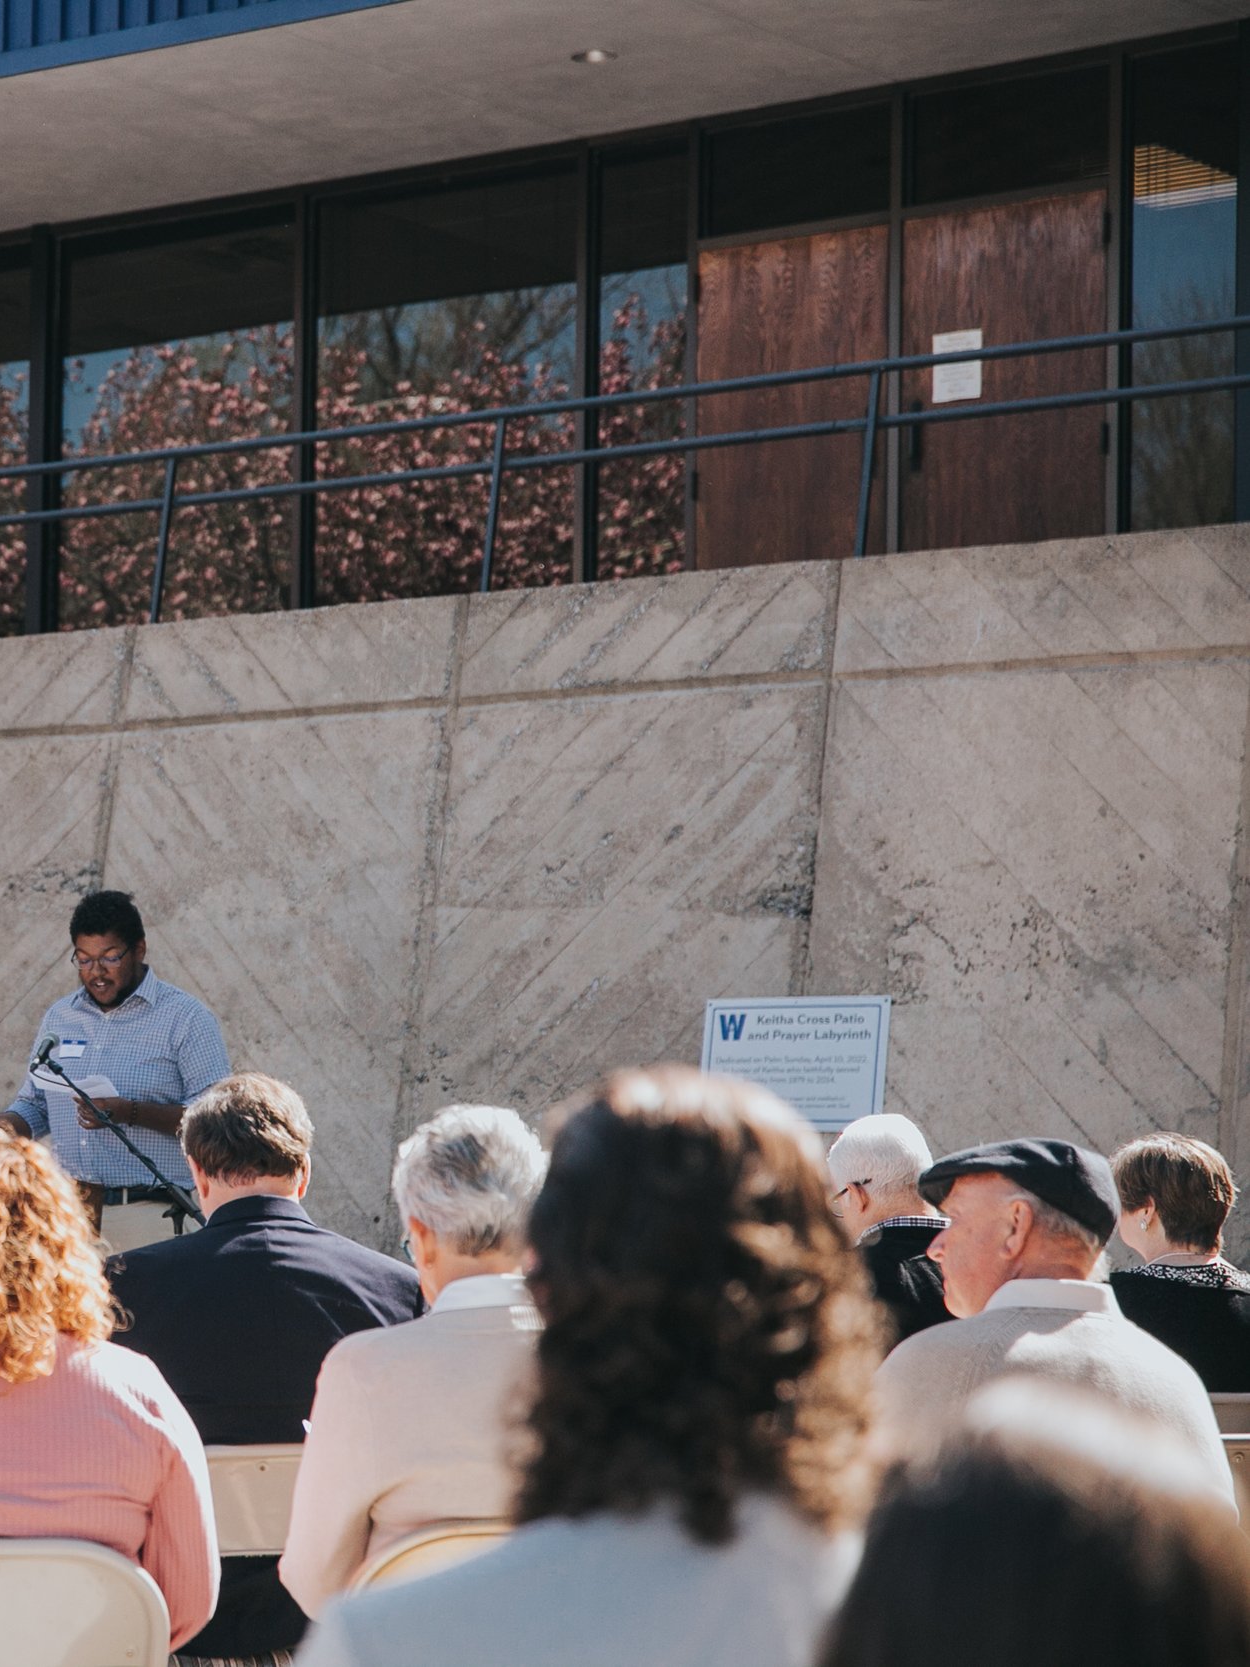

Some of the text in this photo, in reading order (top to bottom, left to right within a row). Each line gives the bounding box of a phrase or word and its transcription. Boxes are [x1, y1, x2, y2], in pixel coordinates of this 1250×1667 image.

[757, 1012, 866, 1025] Keitha Cross Patio
[719, 1014, 747, 1041] W
[747, 1028, 871, 1042] and Prayer Labyrinth
[716, 1055, 751, 1064] Dedicated
[814, 1055, 831, 1065] April
[763, 1066, 785, 1075] Keitha
